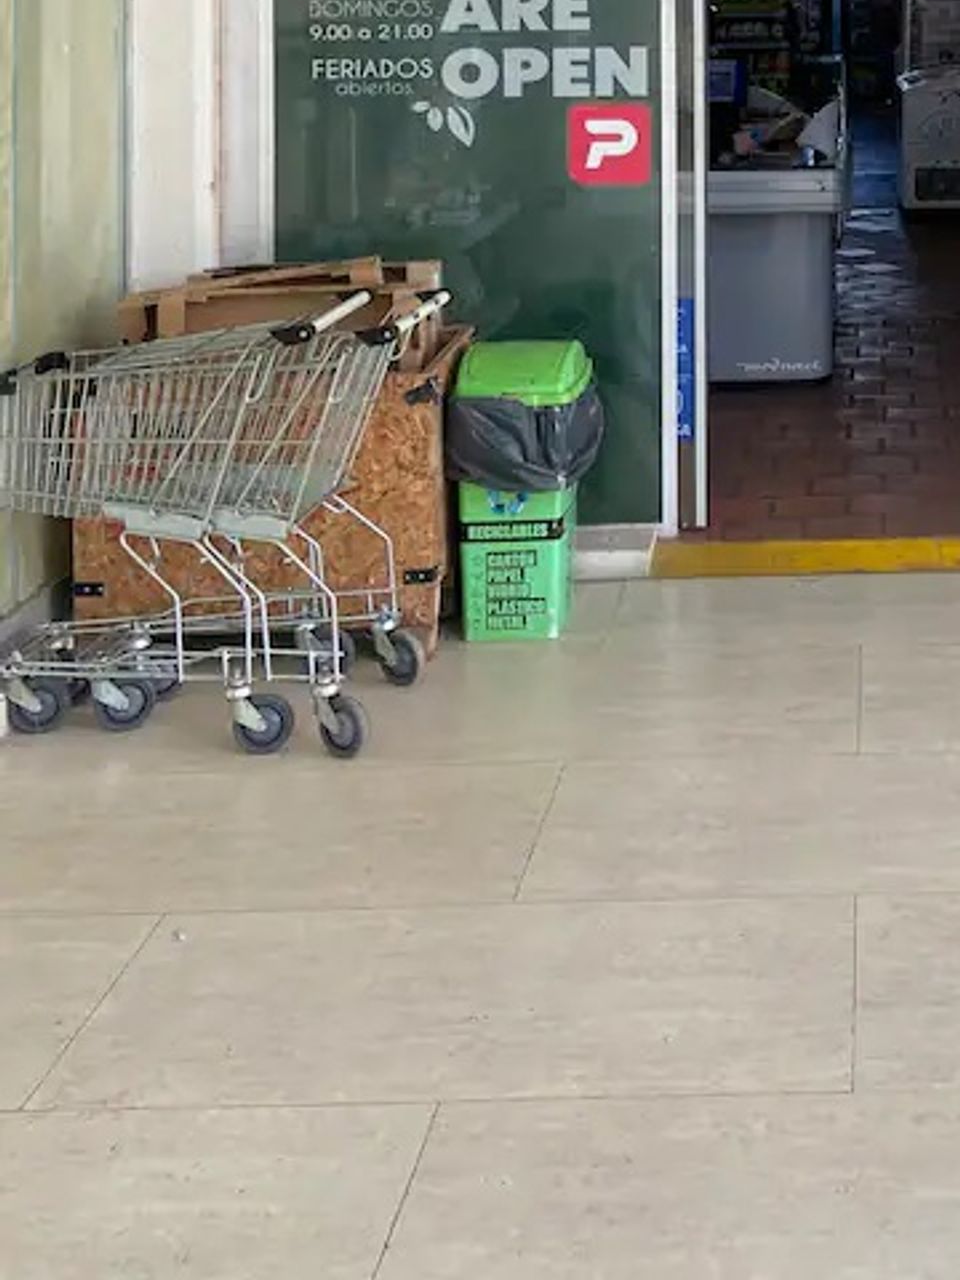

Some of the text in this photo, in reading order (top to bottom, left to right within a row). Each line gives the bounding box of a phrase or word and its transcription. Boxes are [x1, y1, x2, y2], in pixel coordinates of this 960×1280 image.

[309, 0, 434, 19] DOMINGOS
[309, 24, 352, 41] 9.00
[377, 24, 434, 40] 21.00
[311, 58, 434, 79] FERIADOS
[440, 46, 649, 99] OPEN
